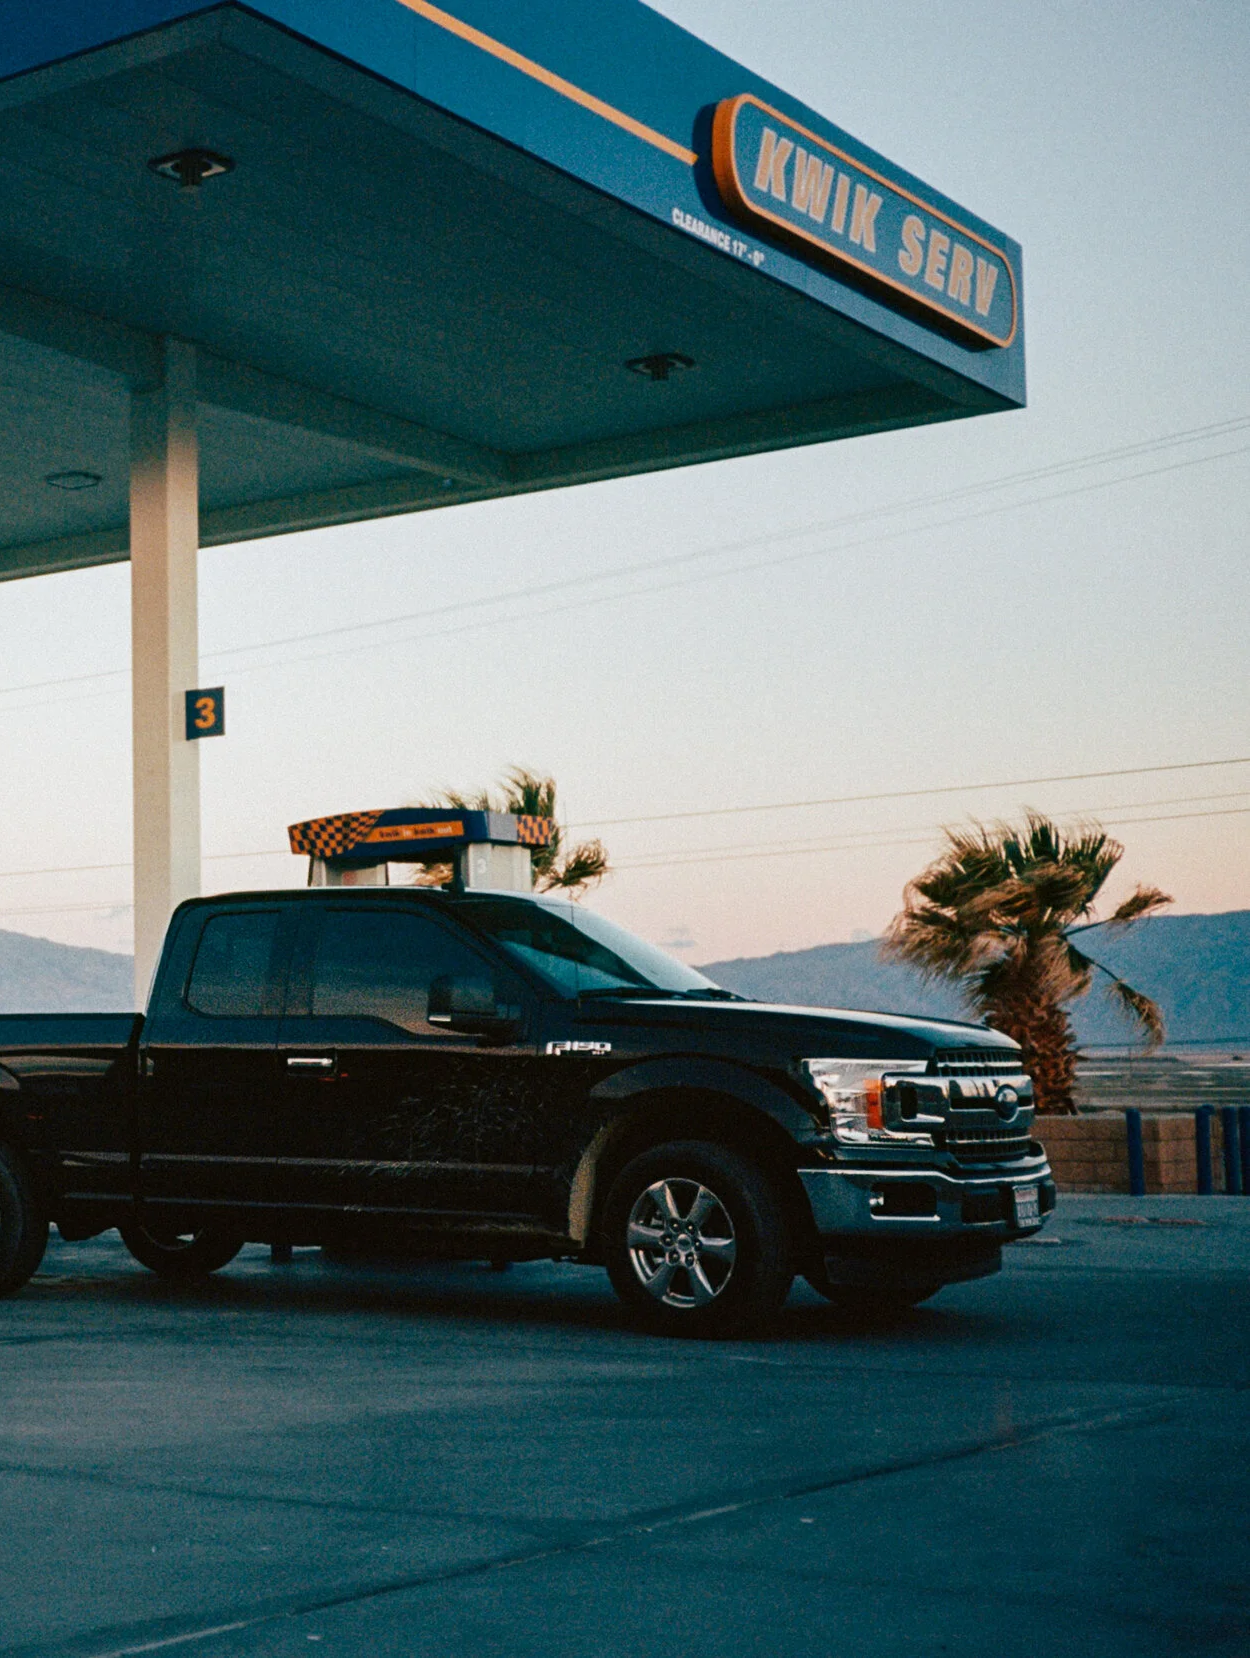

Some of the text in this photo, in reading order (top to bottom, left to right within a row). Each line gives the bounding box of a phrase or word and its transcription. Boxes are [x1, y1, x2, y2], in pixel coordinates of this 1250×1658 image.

[672, 207, 731, 252] CLEARANCE
[754, 126, 999, 317] KWIK SERV
[194, 696, 215, 728] 3
